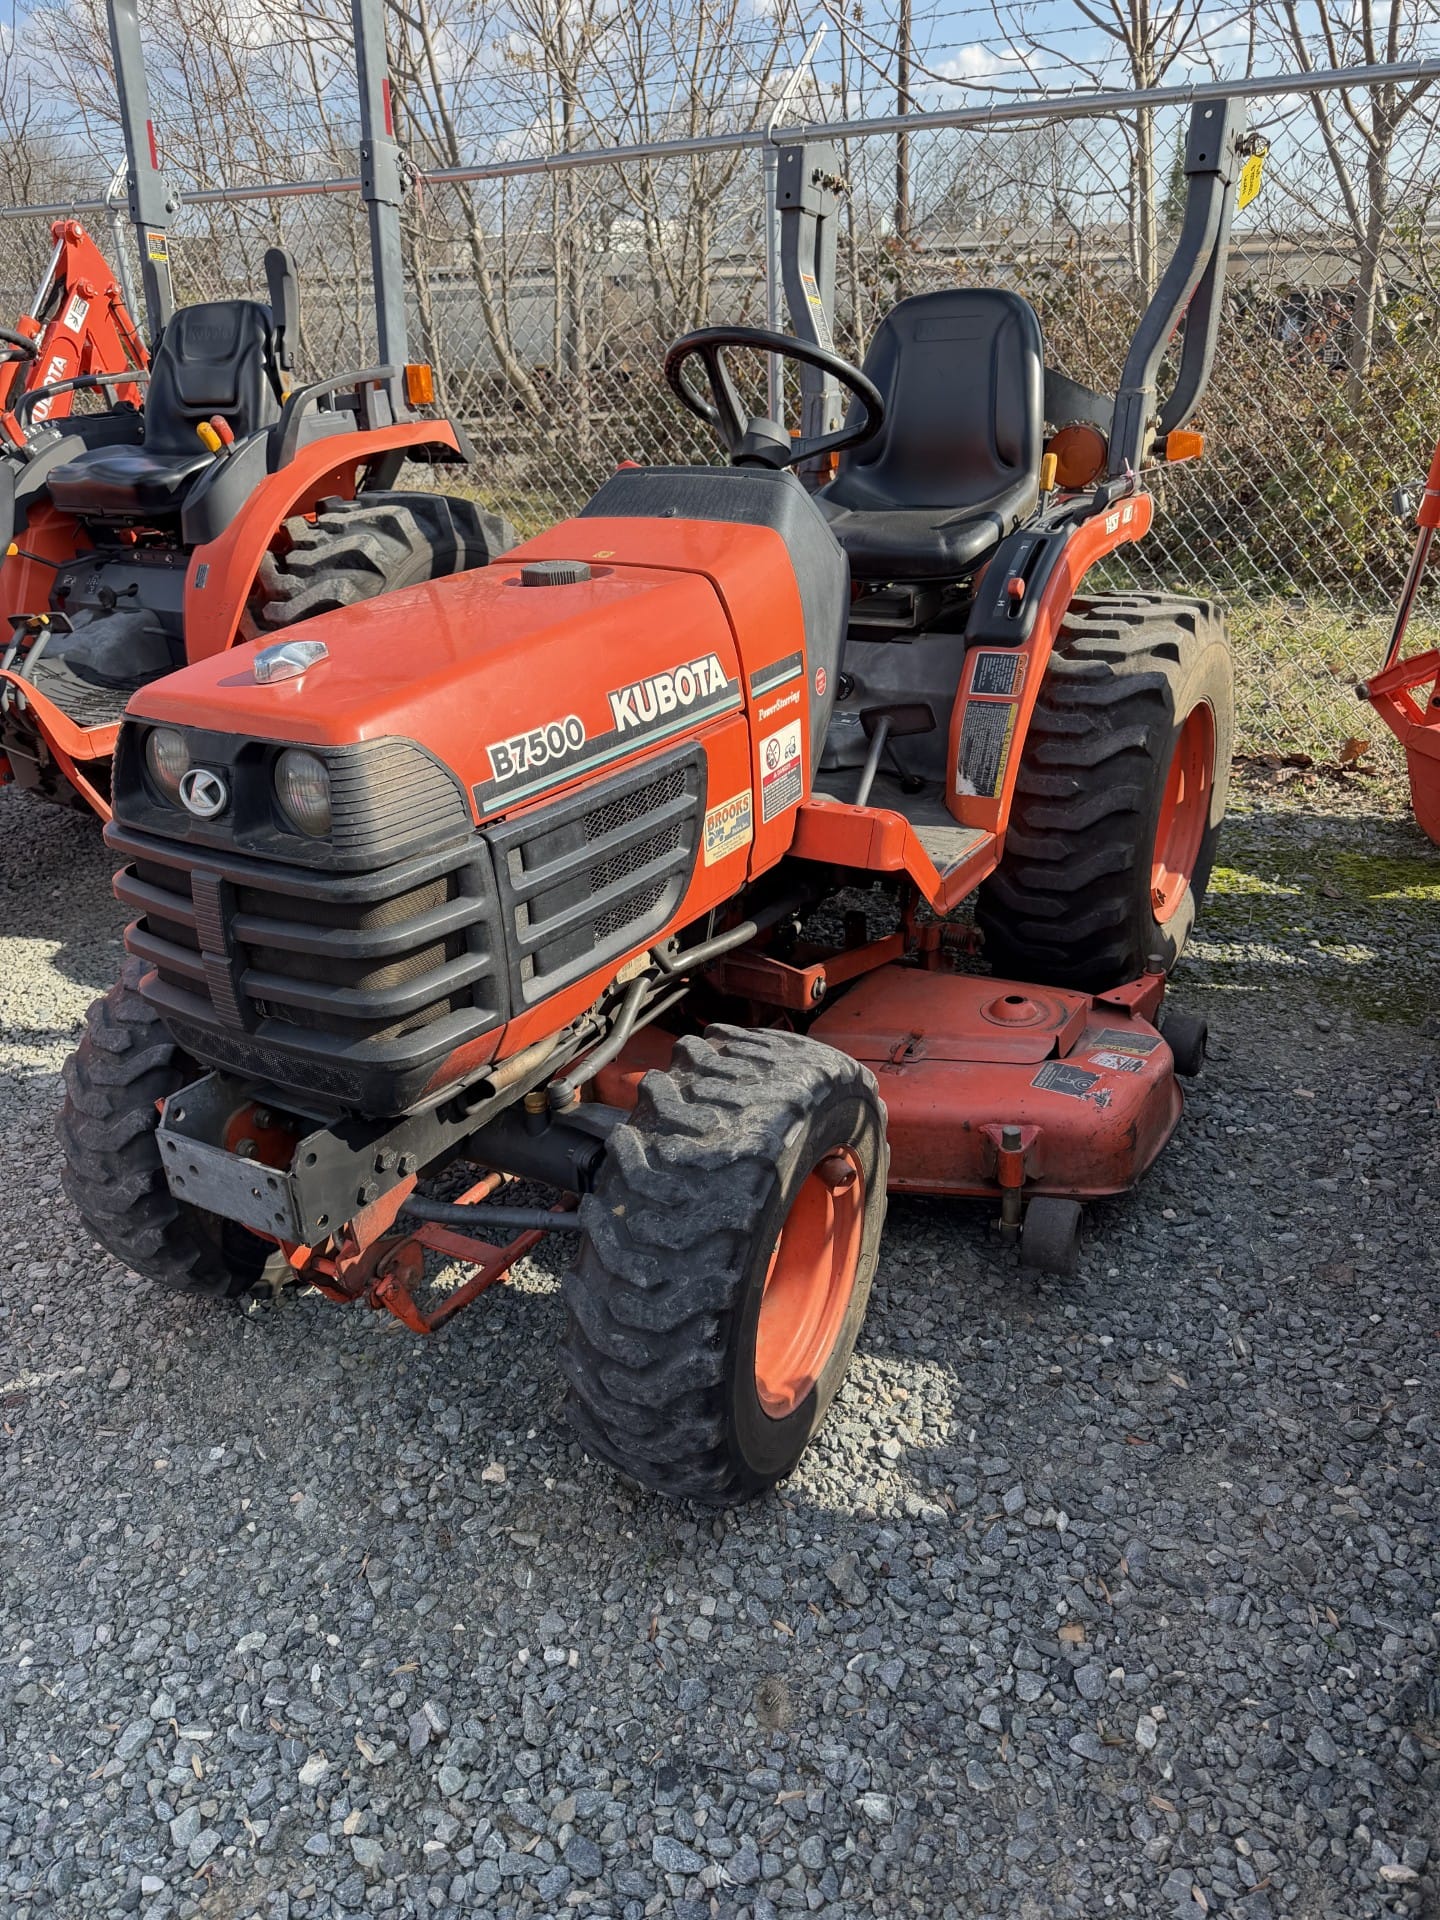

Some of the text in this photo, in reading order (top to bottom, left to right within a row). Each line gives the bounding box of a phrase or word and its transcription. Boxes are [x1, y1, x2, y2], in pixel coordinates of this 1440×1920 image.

[612, 655, 729, 732] KUBOTA
[487, 715, 584, 782] B7500
[706, 796, 749, 833] BROOKS
